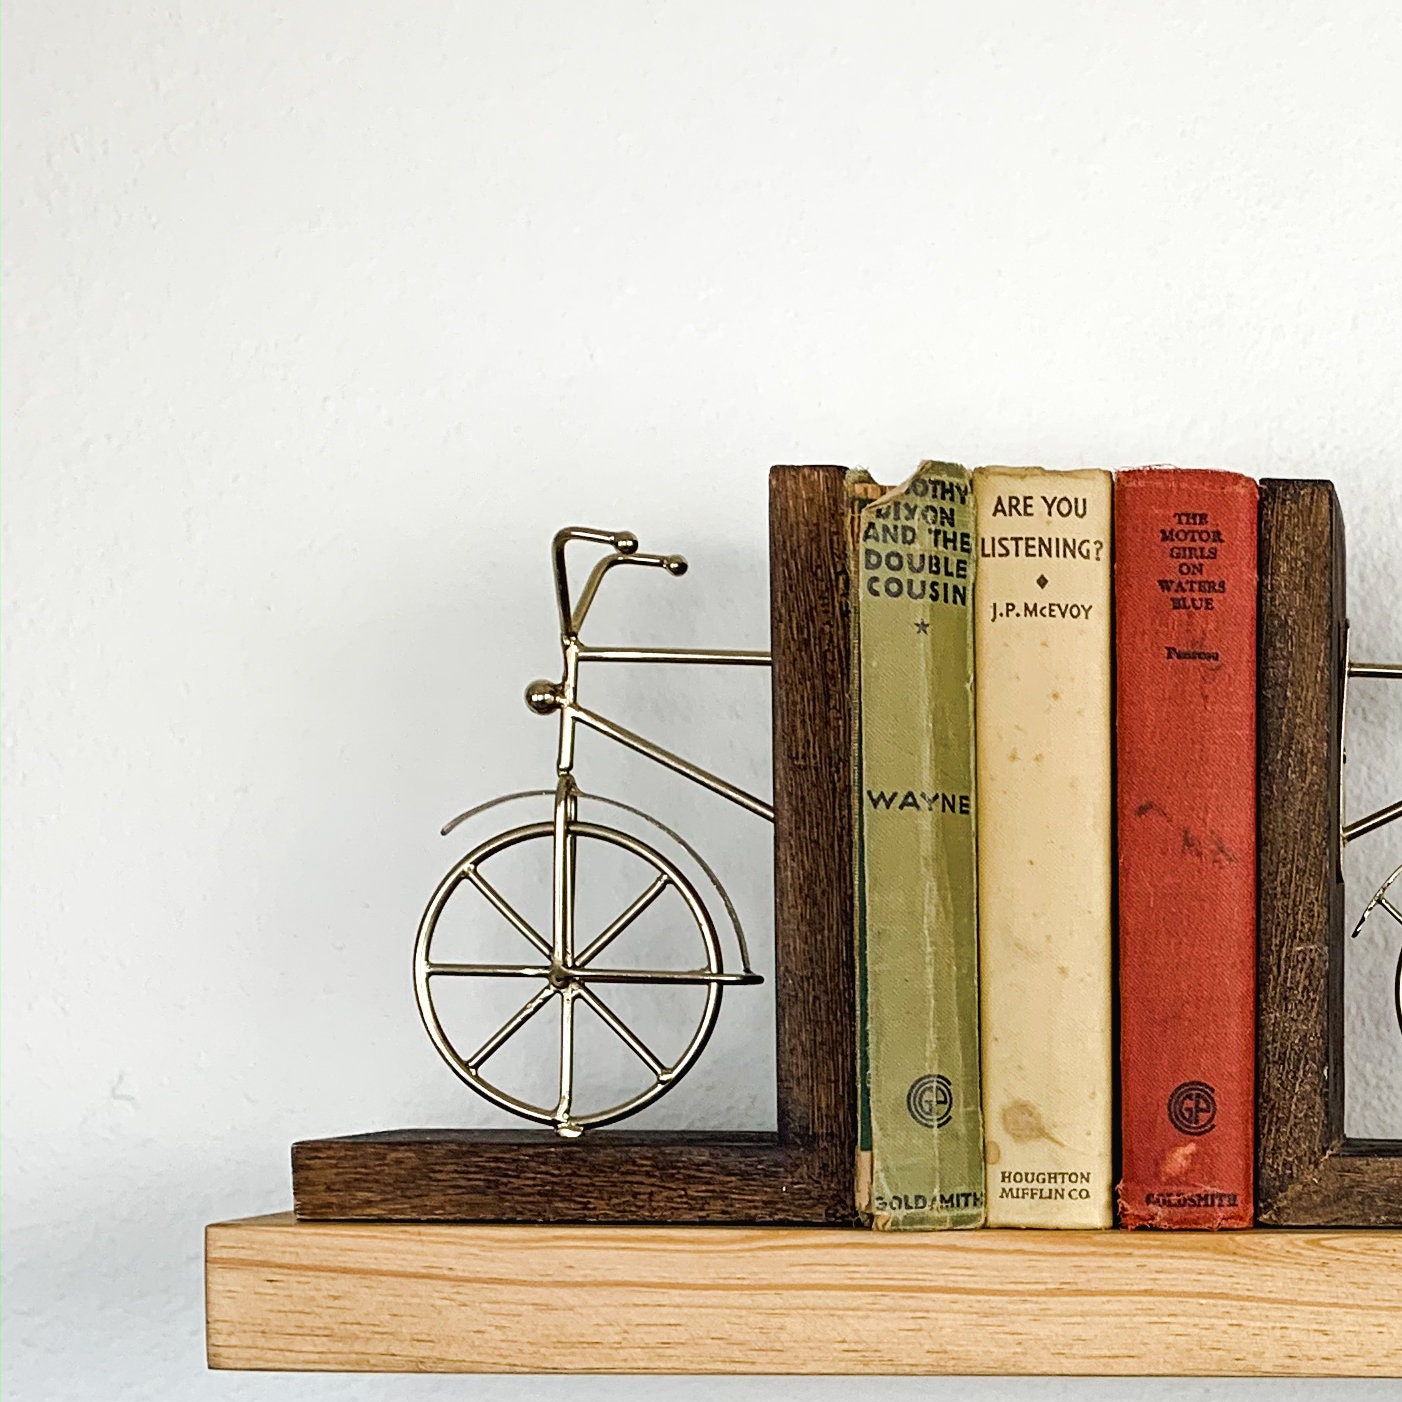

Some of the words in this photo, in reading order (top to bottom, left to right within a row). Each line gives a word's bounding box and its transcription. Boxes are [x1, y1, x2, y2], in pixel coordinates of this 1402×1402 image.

[905, 478, 968, 505] OTHY
[991, 495, 1035, 517] ARE
[1040, 495, 1087, 519] YOU
[1173, 512, 1209, 526] THE
[862, 521, 916, 545] AND
[928, 528, 971, 554] THE
[1160, 528, 1224, 544] MOTOR
[980, 536, 1104, 561] LISTENING?
[1169, 546, 1218, 560] GIRLS
[864, 548, 968, 579] DOUBLE
[1178, 562, 1204, 576] ON
[866, 575, 967, 606] COUSIN
[1157, 579, 1227, 594] WATERS
[1170, 597, 1215, 611] BLUE
[866, 790, 971, 815] WAYNE
[1000, 1171, 1091, 1184] HOUGHTON
[998, 1187, 1065, 1200] MIFFLIN
